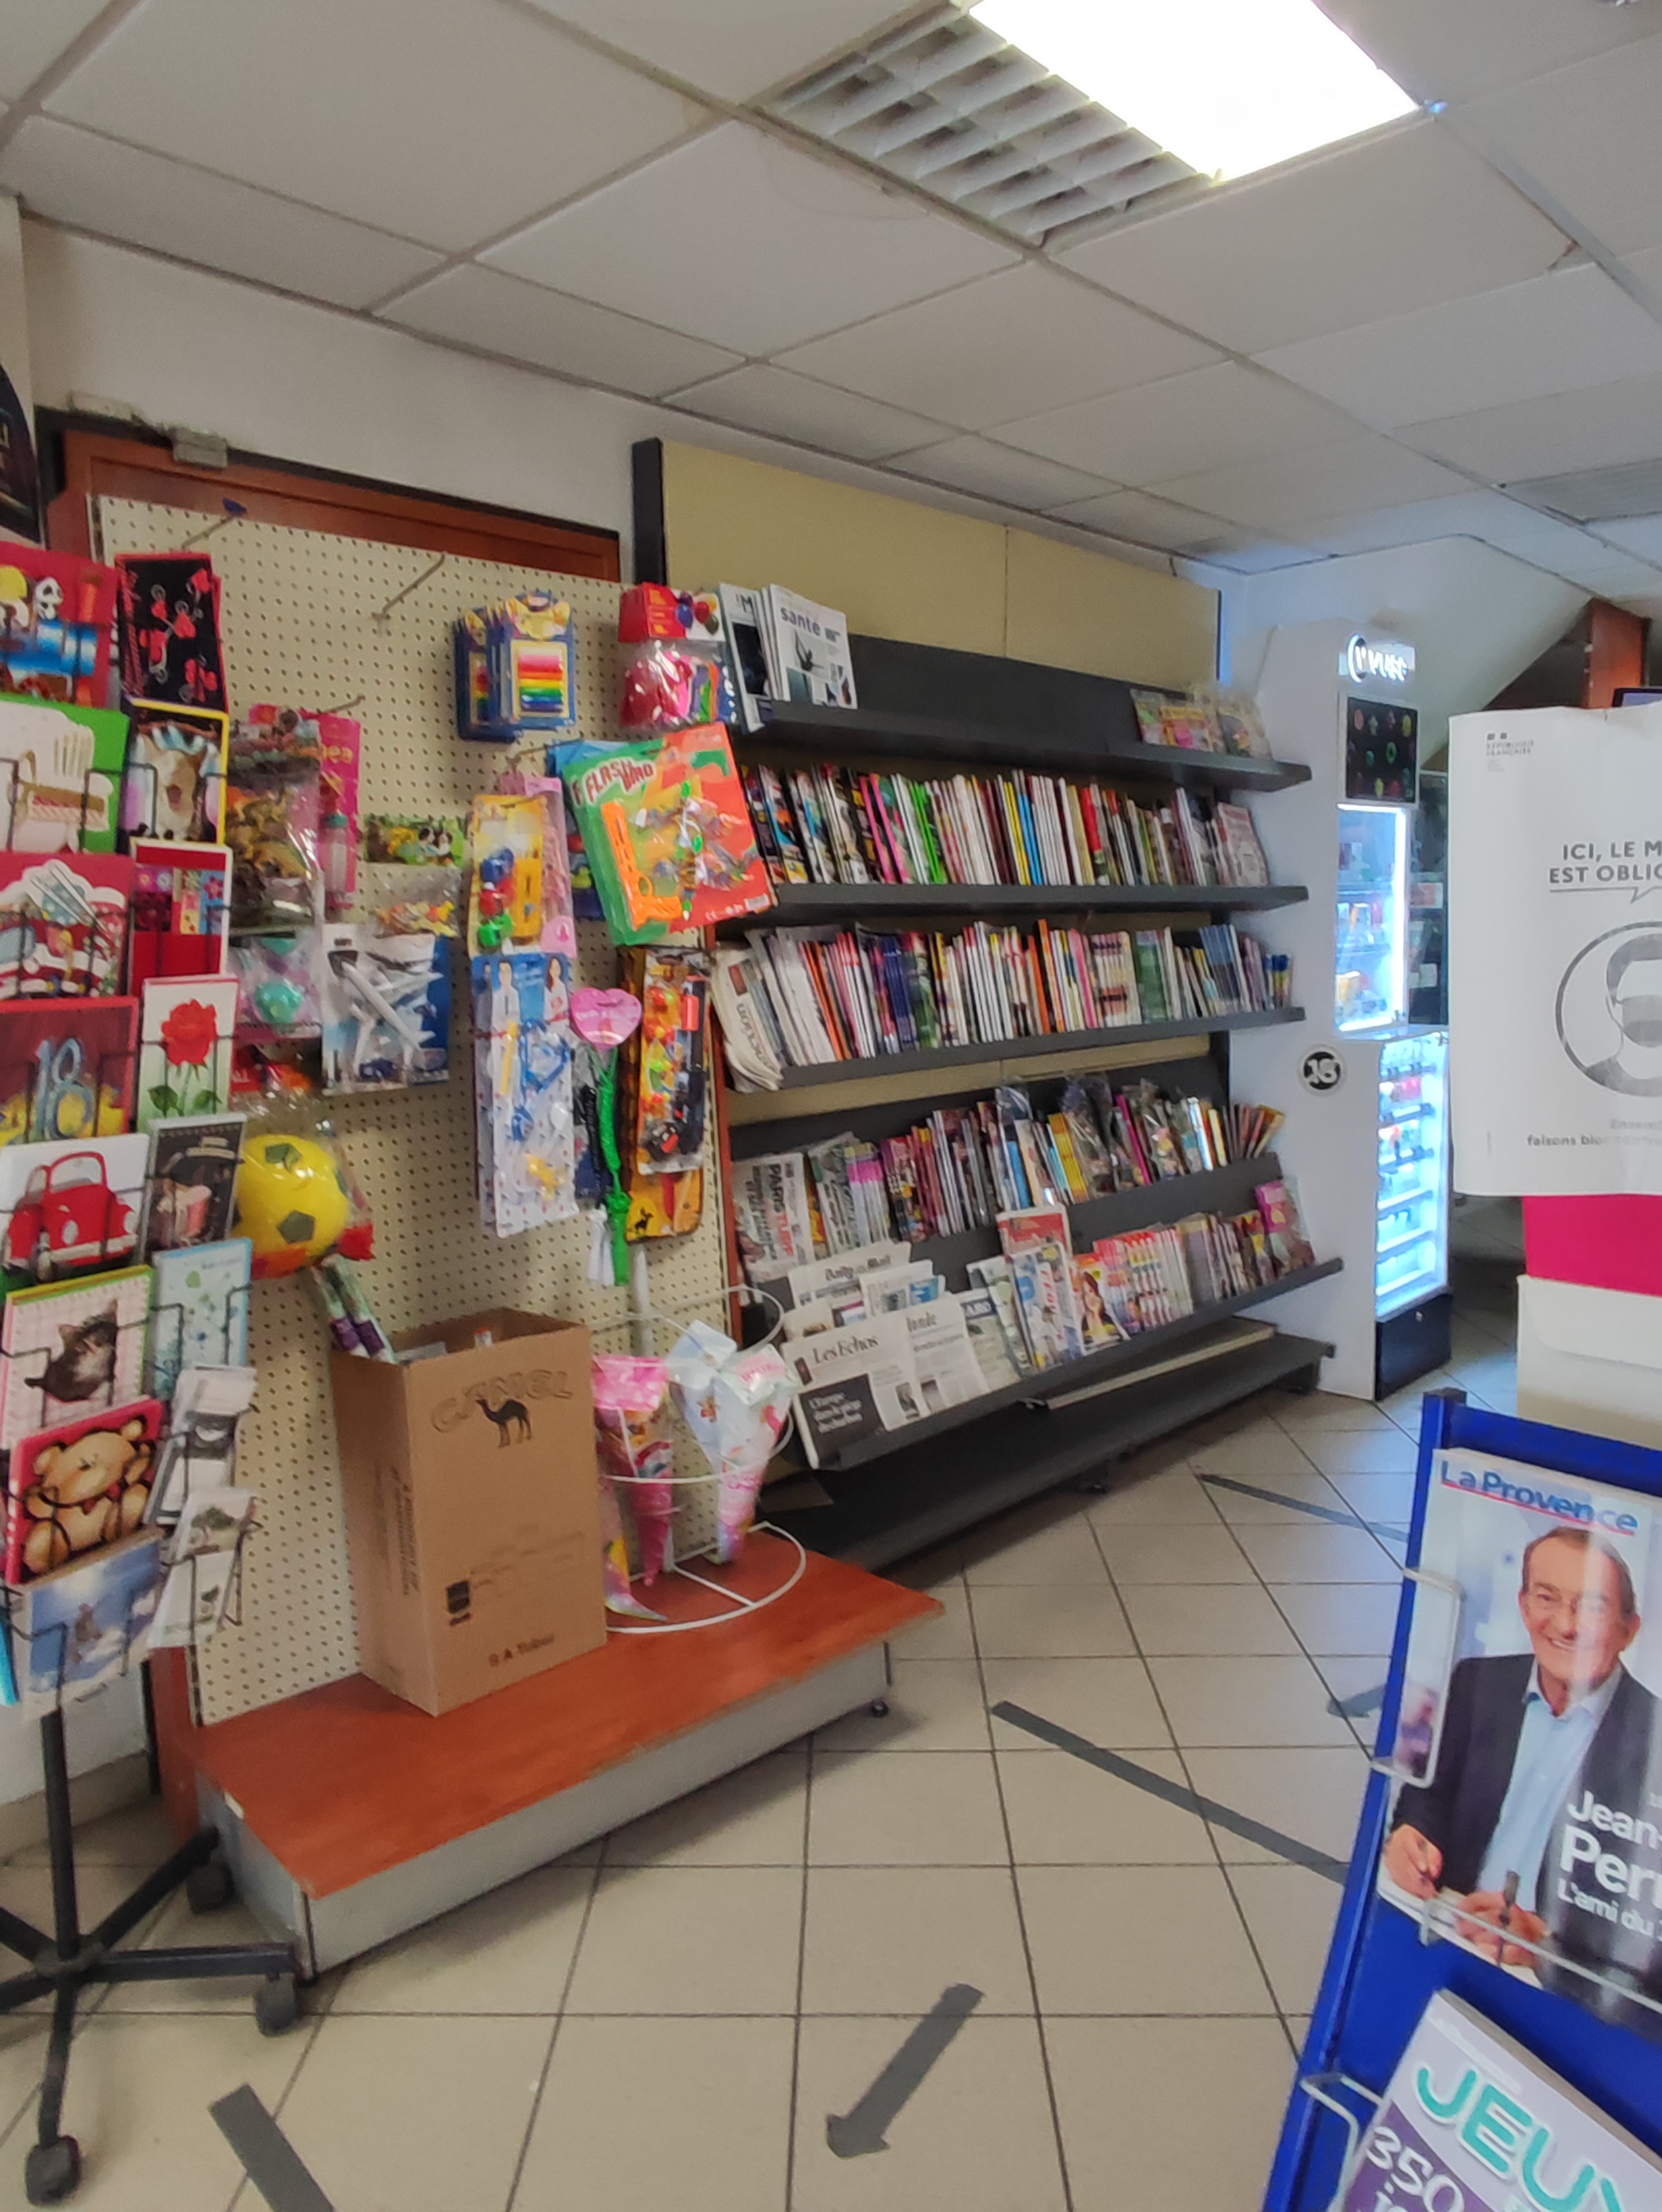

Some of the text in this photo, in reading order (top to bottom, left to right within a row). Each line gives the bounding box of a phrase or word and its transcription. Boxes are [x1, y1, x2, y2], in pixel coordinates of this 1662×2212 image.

[1563, 842, 1602, 863] ICI,
[1611, 841, 1636, 858] LE
[1549, 866, 1589, 884] EST
[1526, 1134, 1577, 1146] faisons
[1441, 1460, 1638, 1530] La Provence
[1365, 2126, 1465, 2212] 350
